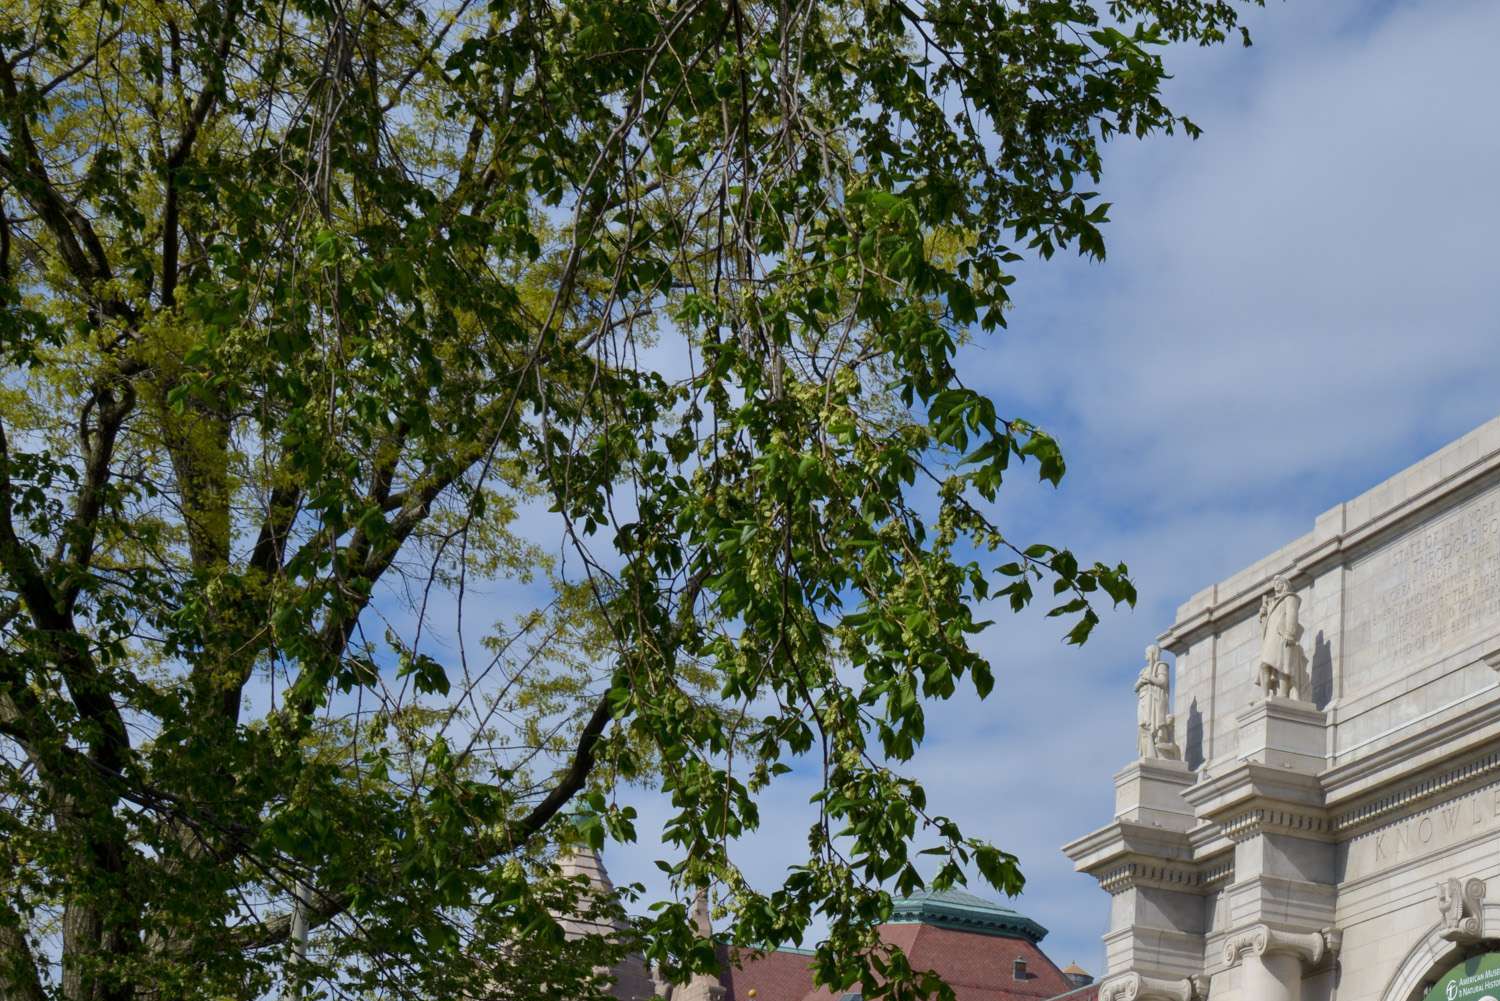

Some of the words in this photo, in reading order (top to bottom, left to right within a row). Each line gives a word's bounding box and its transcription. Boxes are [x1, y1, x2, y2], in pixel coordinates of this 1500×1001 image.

[1412, 526, 1477, 575] THEODORE
[1459, 973, 1484, 987] AMERICAN
[1463, 985, 1484, 996] NATURAL
